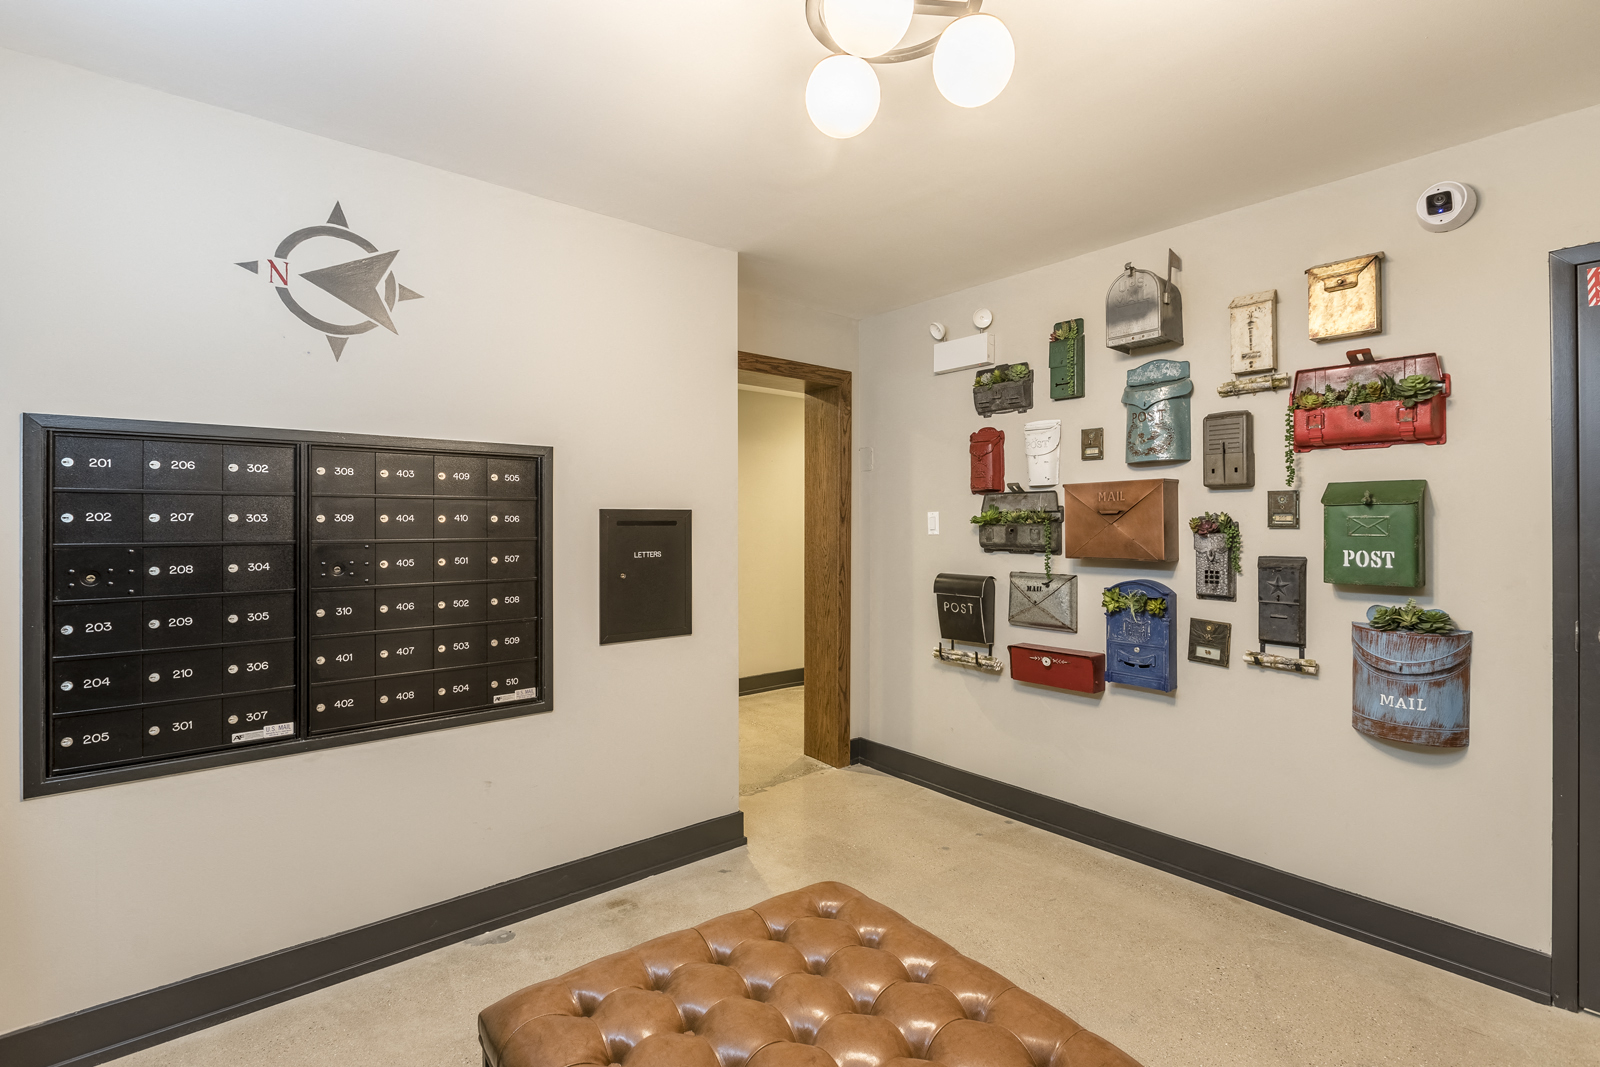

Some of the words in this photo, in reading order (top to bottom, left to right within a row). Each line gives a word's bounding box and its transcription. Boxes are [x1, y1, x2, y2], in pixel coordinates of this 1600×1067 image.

[267, 259, 289, 286] N
[1132, 409, 1166, 423] POST
[1026, 440, 1049, 449] POST
[88, 457, 112, 468] 201
[170, 460, 196, 470] 206
[246, 463, 269, 473] 302
[334, 466, 355, 476] 308
[396, 469, 415, 478] 403
[452, 472, 470, 481] 409
[504, 474, 520, 482] 505
[1098, 491, 1126, 502] MAIL
[85, 512, 112, 522] 202
[170, 512, 195, 522] 207
[245, 513, 269, 523] 303
[333, 513, 355, 523] 309
[395, 514, 415, 523] 404
[453, 514, 469, 522] 410
[504, 515, 520, 523] 506
[504, 554, 520, 563] 507
[633, 550, 662, 559] LETTERS
[1343, 550, 1394, 568] POST
[396, 558, 415, 567] 405
[454, 556, 469, 565] 501
[169, 564, 194, 575] 208
[247, 562, 271, 572] 304
[452, 599, 470, 608] 502
[504, 595, 520, 604] 508
[335, 606, 353, 616] 310
[395, 602, 415, 611] 406
[944, 602, 973, 614] POST
[247, 611, 270, 622] 305
[85, 621, 113, 633] 203
[168, 616, 193, 628] 209
[504, 636, 520, 645] 509
[396, 646, 415, 656] 407
[452, 641, 470, 651] 503
[335, 653, 353, 663] 401
[246, 661, 269, 672] 306
[172, 668, 193, 679] 210
[83, 676, 111, 689] 204
[505, 677, 519, 686] 510
[452, 683, 470, 694] 504
[395, 690, 415, 701] 408
[334, 698, 354, 708] 402
[1380, 694, 1426, 711] MAIL
[245, 710, 268, 722] 307
[172, 720, 193, 732] 301
[82, 731, 110, 745] 205
